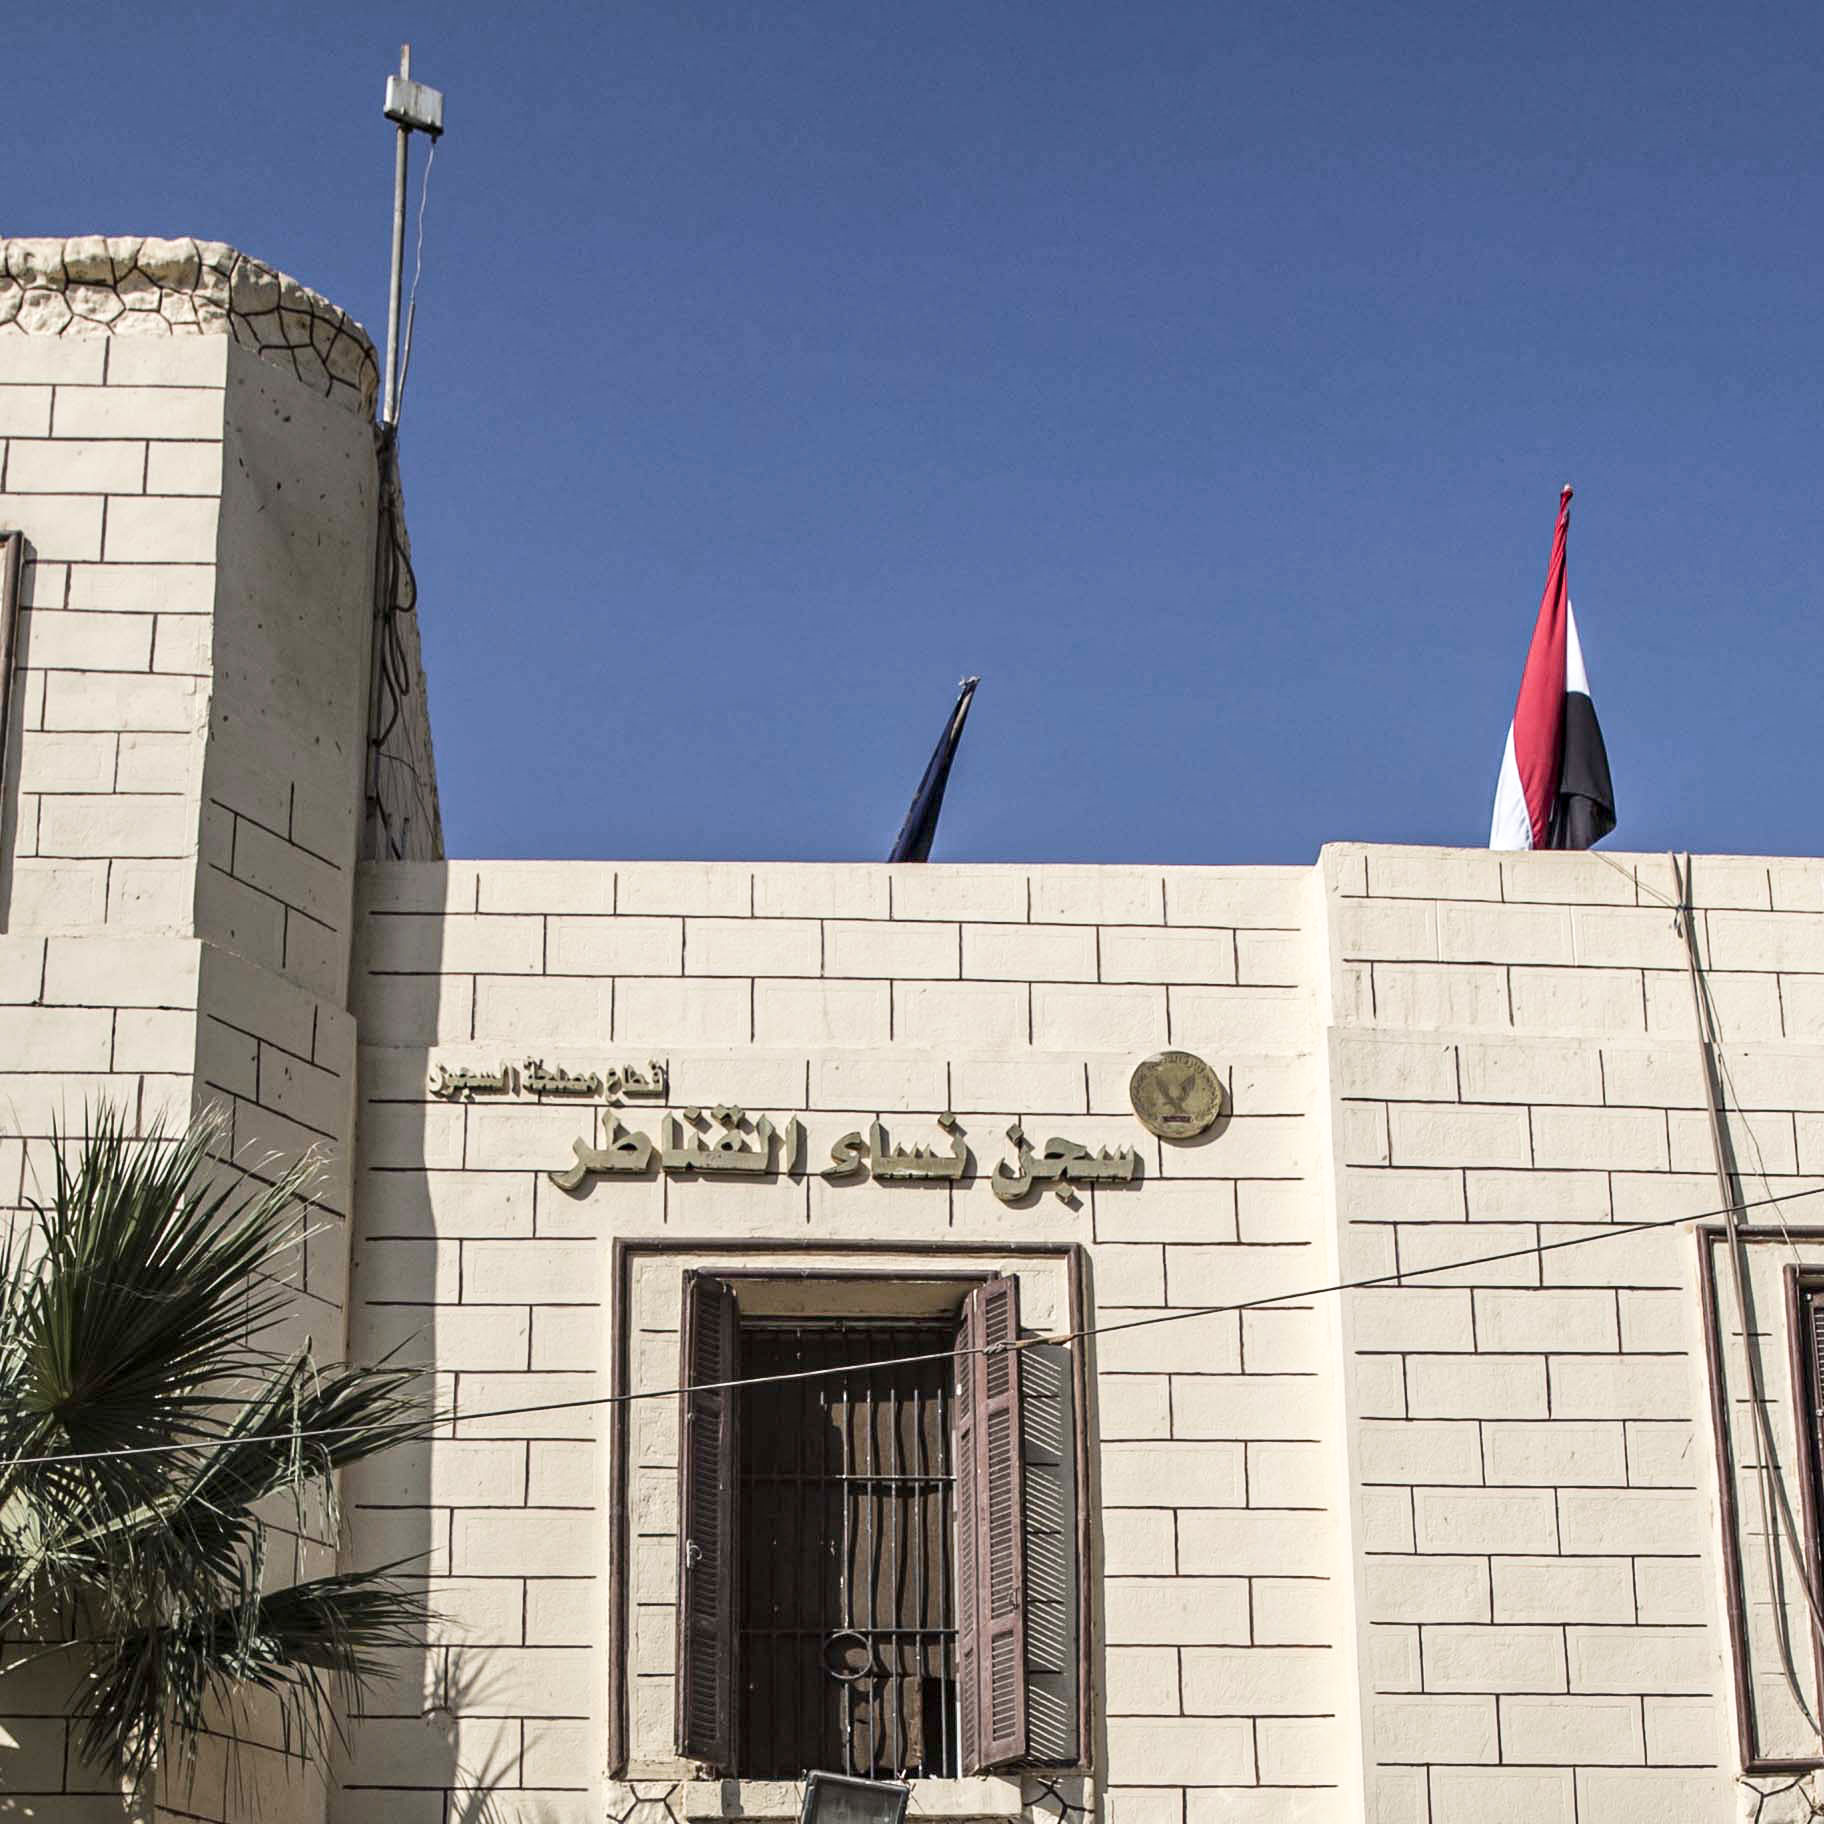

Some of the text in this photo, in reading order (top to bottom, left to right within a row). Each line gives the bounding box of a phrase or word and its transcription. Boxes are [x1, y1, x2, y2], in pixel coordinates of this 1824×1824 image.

[428, 1059, 519, 1102] السجون
[523, 1057, 600, 1092] مصلحة
[549, 1104, 1139, 1202] سجن نساء القناطر
